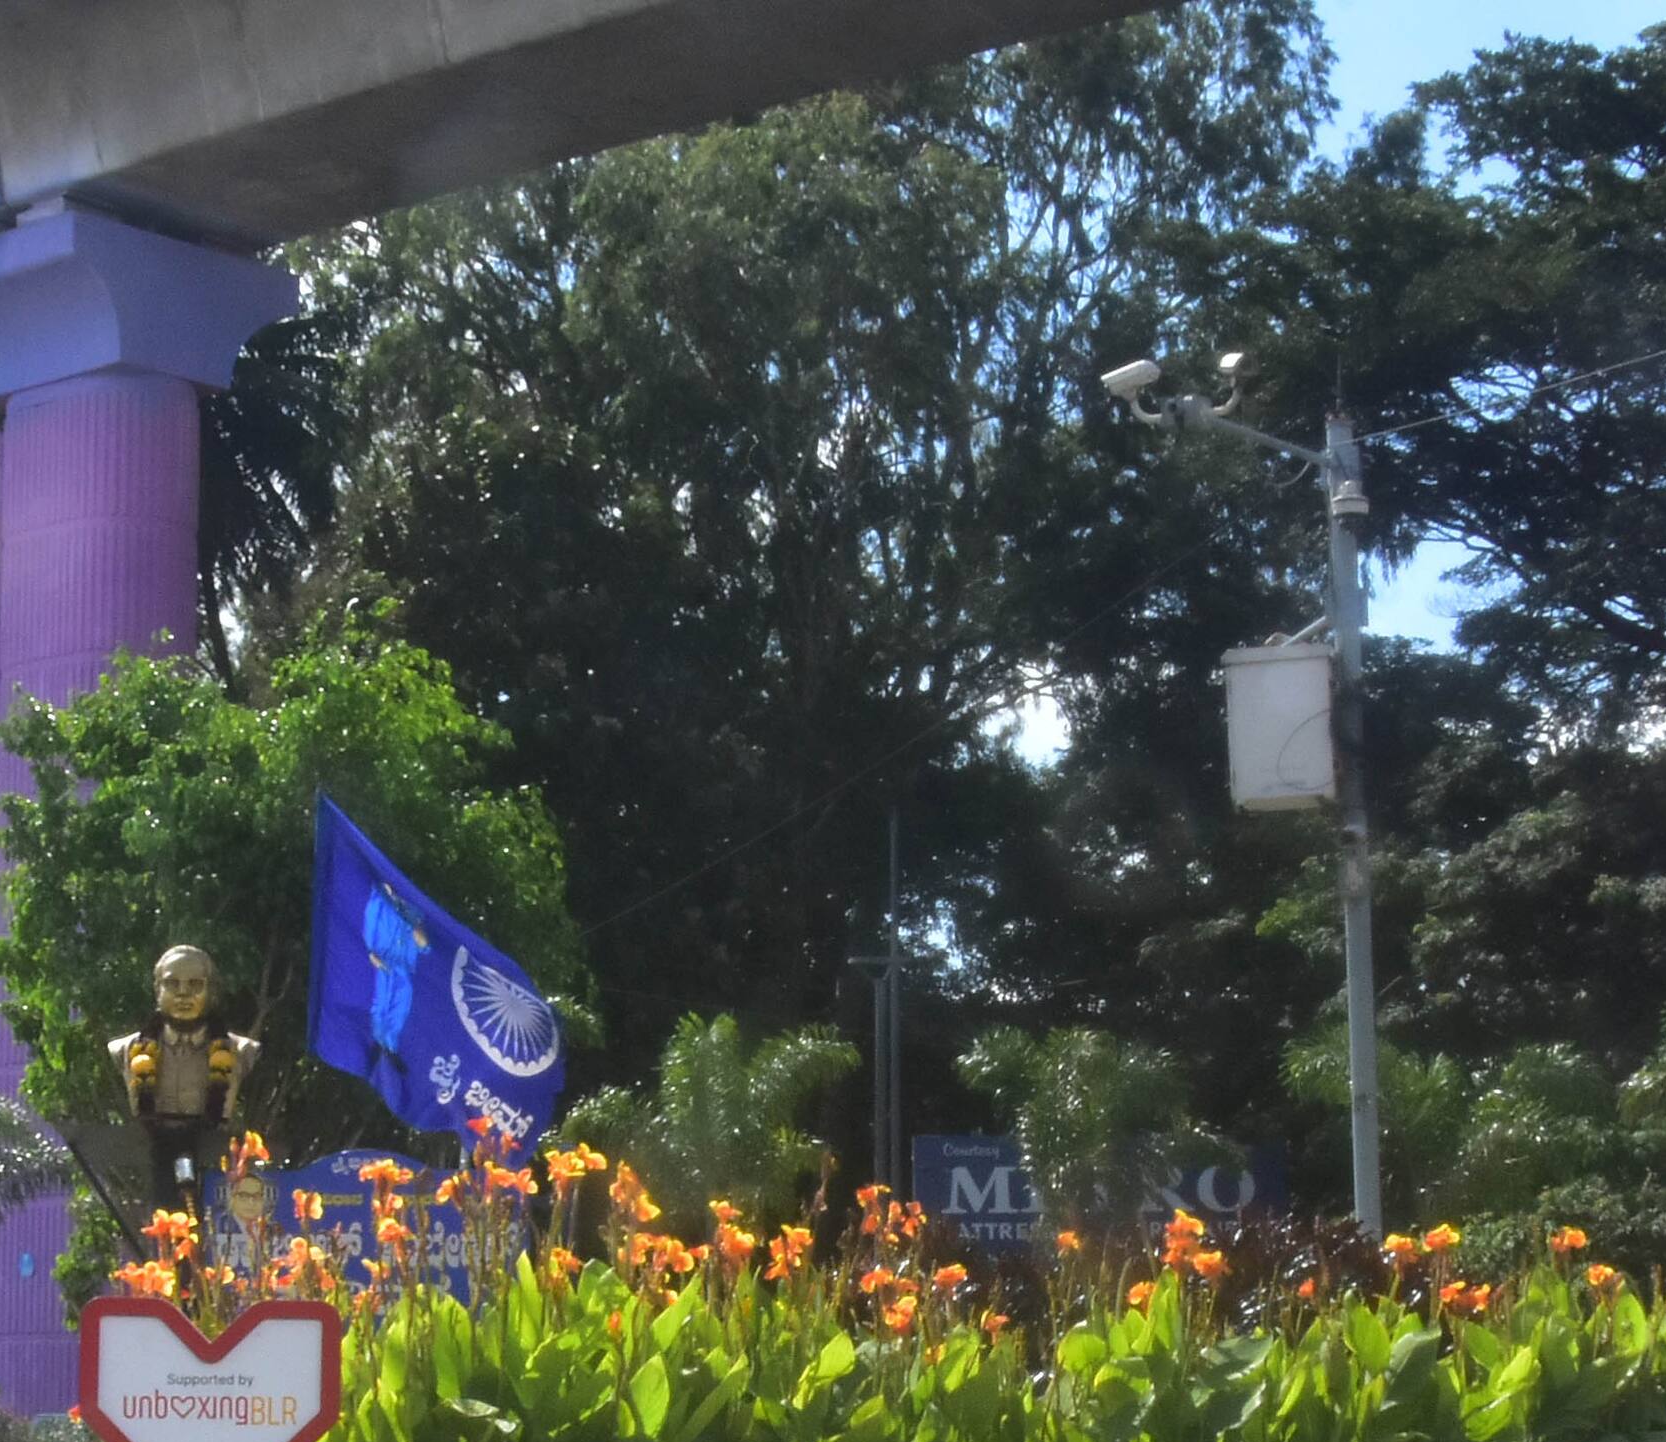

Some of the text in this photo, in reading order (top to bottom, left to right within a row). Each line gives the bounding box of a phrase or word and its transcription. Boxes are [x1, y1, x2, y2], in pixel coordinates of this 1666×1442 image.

[943, 1143, 1000, 1159] Courtesy
[166, 1373, 255, 1388] Supported by
